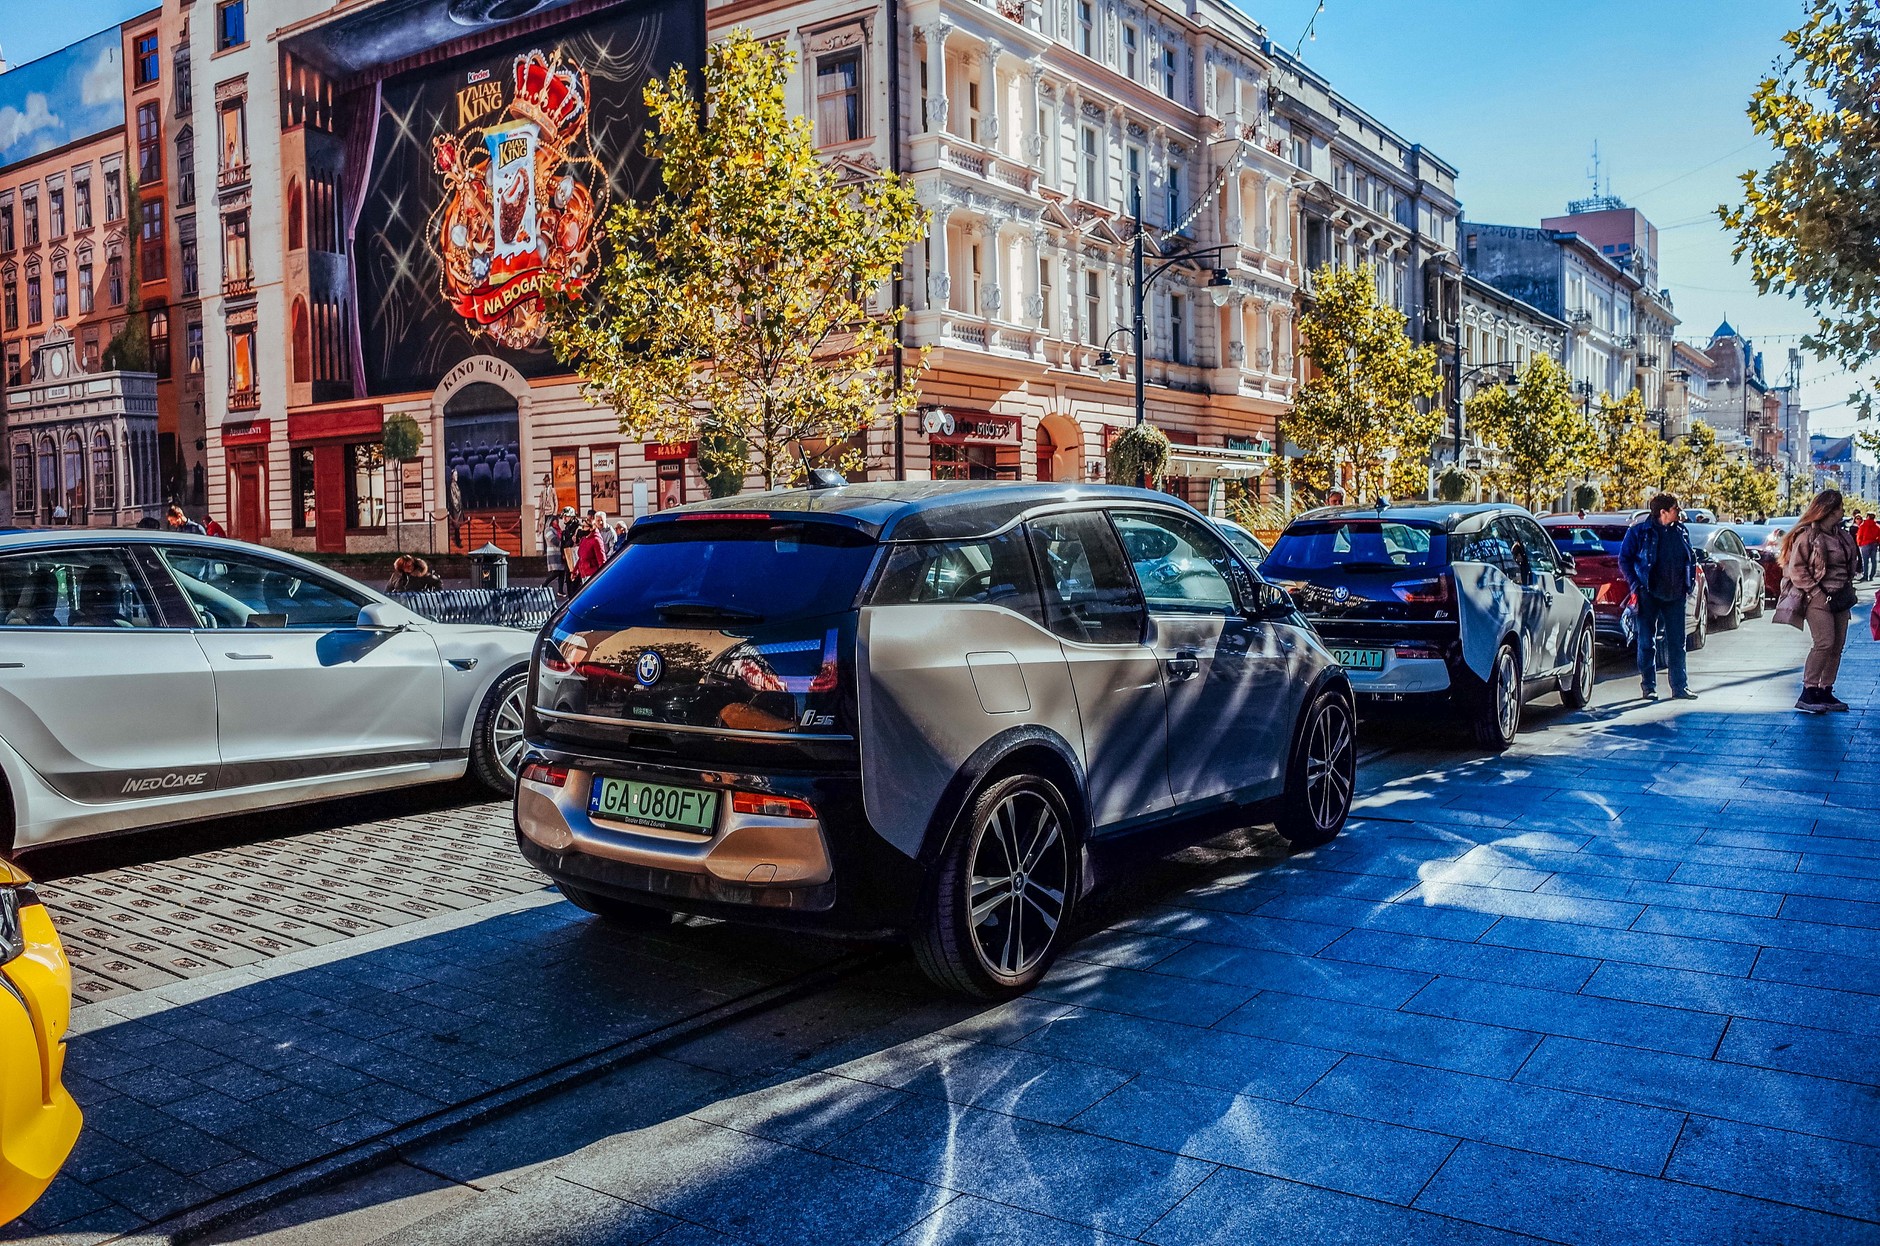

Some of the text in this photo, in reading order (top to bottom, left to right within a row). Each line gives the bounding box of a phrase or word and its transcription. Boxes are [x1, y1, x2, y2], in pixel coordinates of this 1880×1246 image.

[471, 81, 502, 99] MAXI
[456, 86, 502, 130] KING
[499, 140, 527, 168] KING
[483, 296, 504, 315] NA
[443, 361, 475, 392] KINO
[591, 797, 599, 806] PL
[604, 781, 711, 824] GA 080FY
